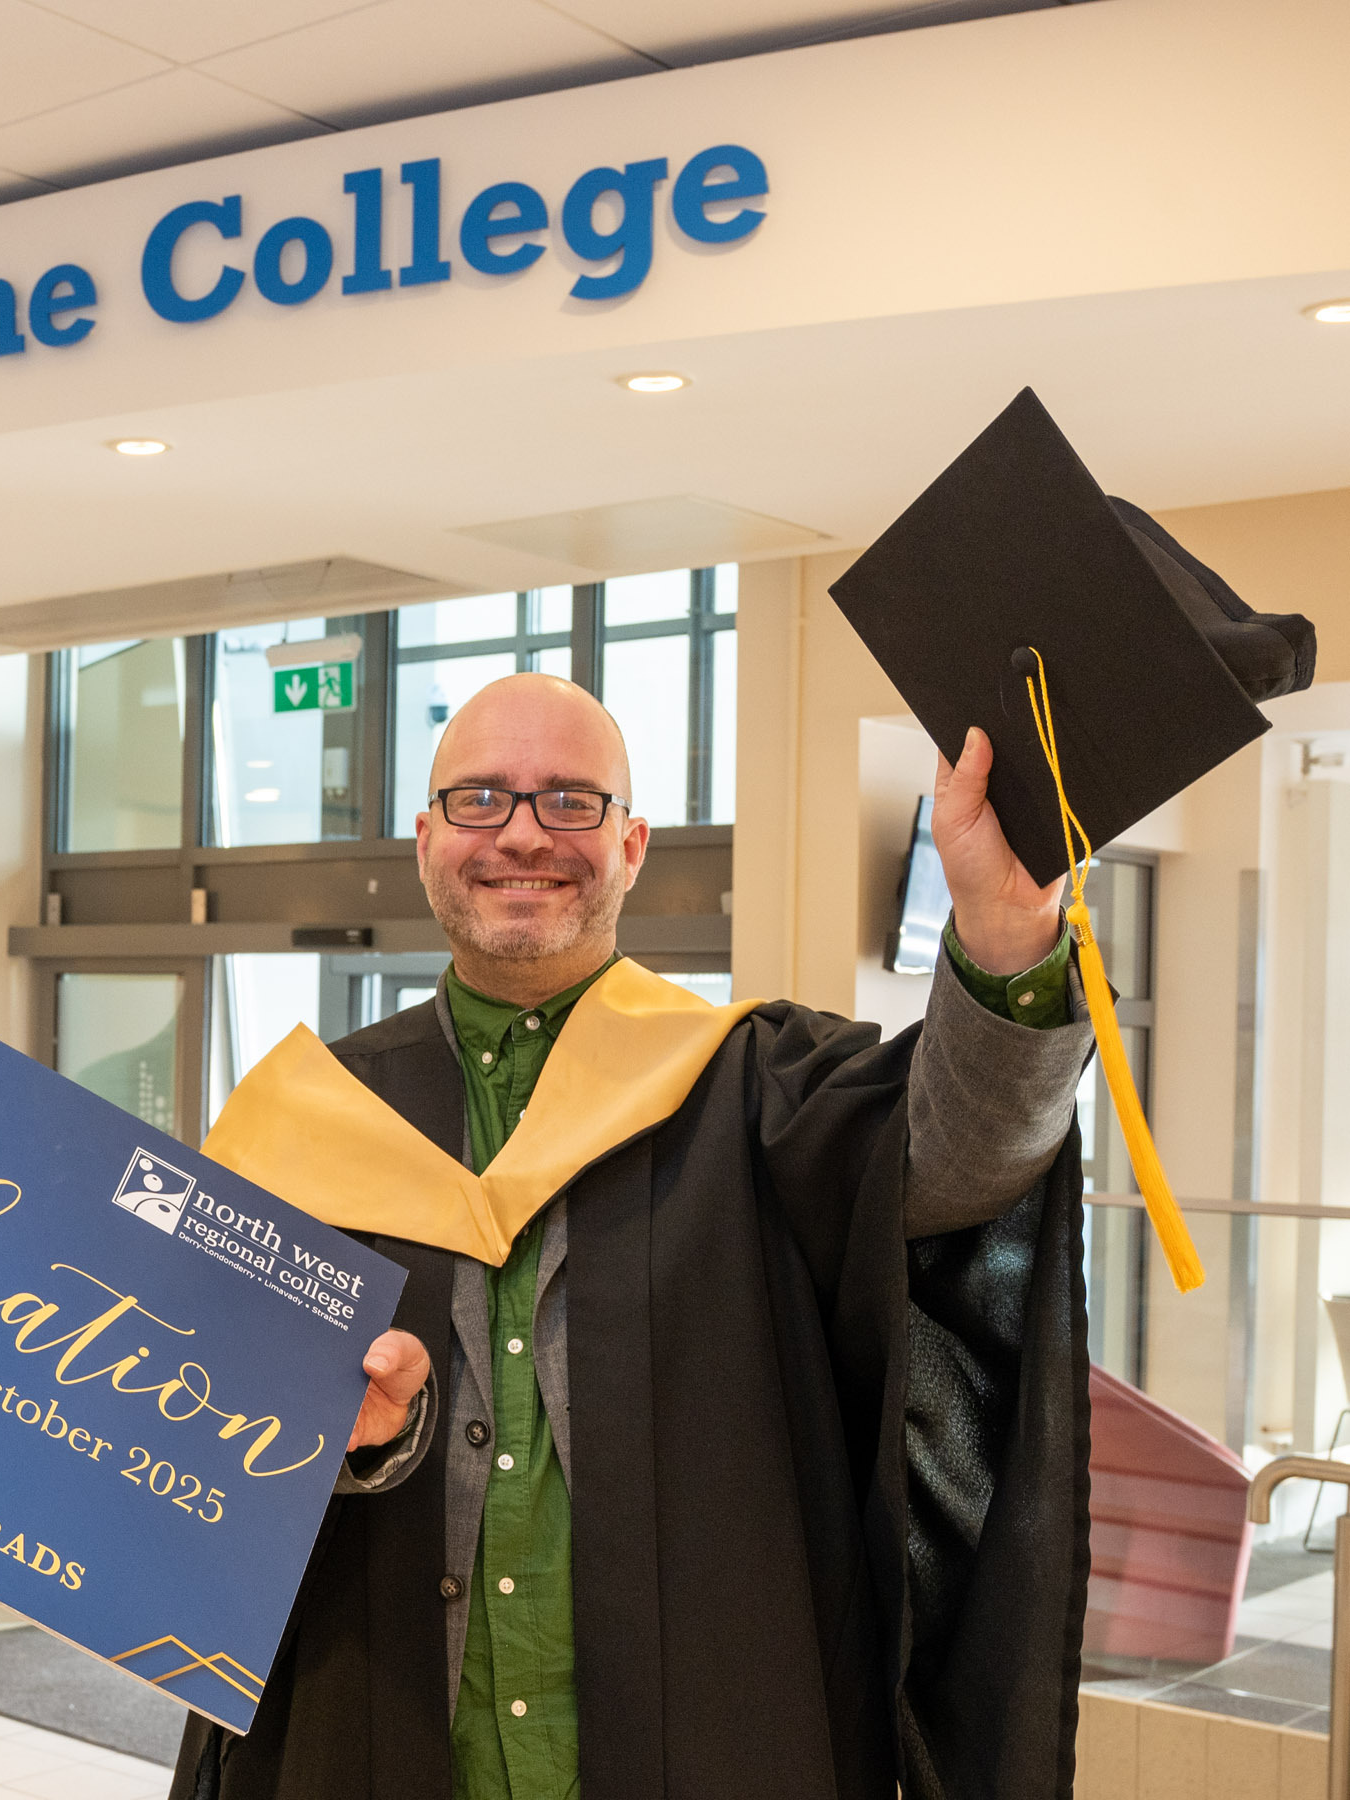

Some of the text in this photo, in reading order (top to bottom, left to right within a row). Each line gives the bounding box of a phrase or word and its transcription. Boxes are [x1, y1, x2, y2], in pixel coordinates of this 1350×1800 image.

[140, 143, 770, 323] College
[178, 1231, 349, 1332] Derry-Londonderry Limavady Strabane
[183, 1215, 355, 1319] regional college
[192, 1190, 365, 1299] north west
[120, 1446, 226, 1523] 2025
